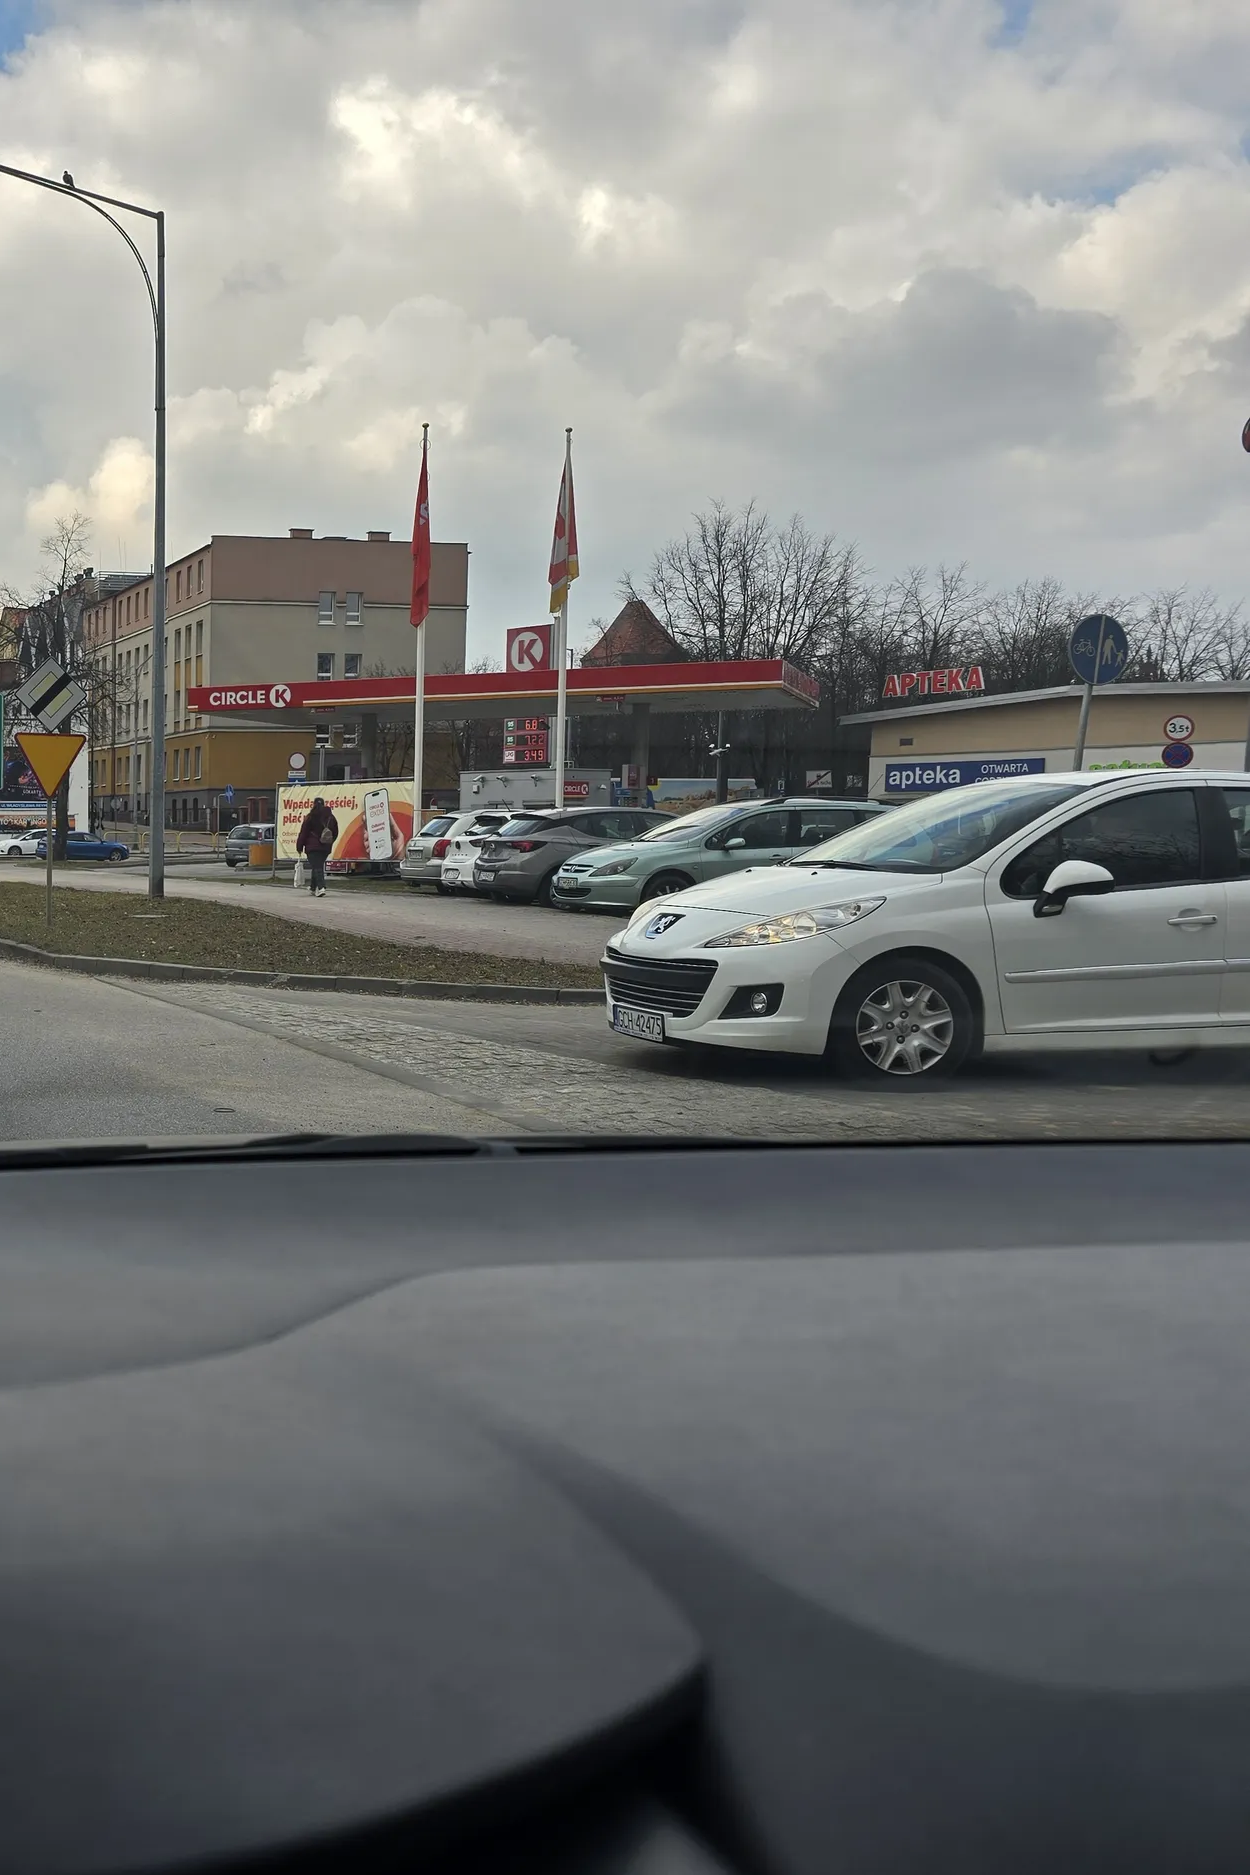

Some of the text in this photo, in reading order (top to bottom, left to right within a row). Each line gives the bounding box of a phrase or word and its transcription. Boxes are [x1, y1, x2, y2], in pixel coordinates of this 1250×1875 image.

[882, 665, 985, 698] APTEKA
[209, 690, 266, 706] CIRCLE
[525, 719, 545, 730] 6.8
[524, 750, 544, 761] 3.49
[980, 763, 1029, 774] OTWARTA
[888, 766, 961, 789] apteka
[564, 785, 581, 793] CIRCLE
[283, 795, 358, 812] Wpada zęściej,
[283, 812, 302, 826] płać
[618, 1009, 634, 1030] GCH
[635, 1013, 662, 1036] 42475
